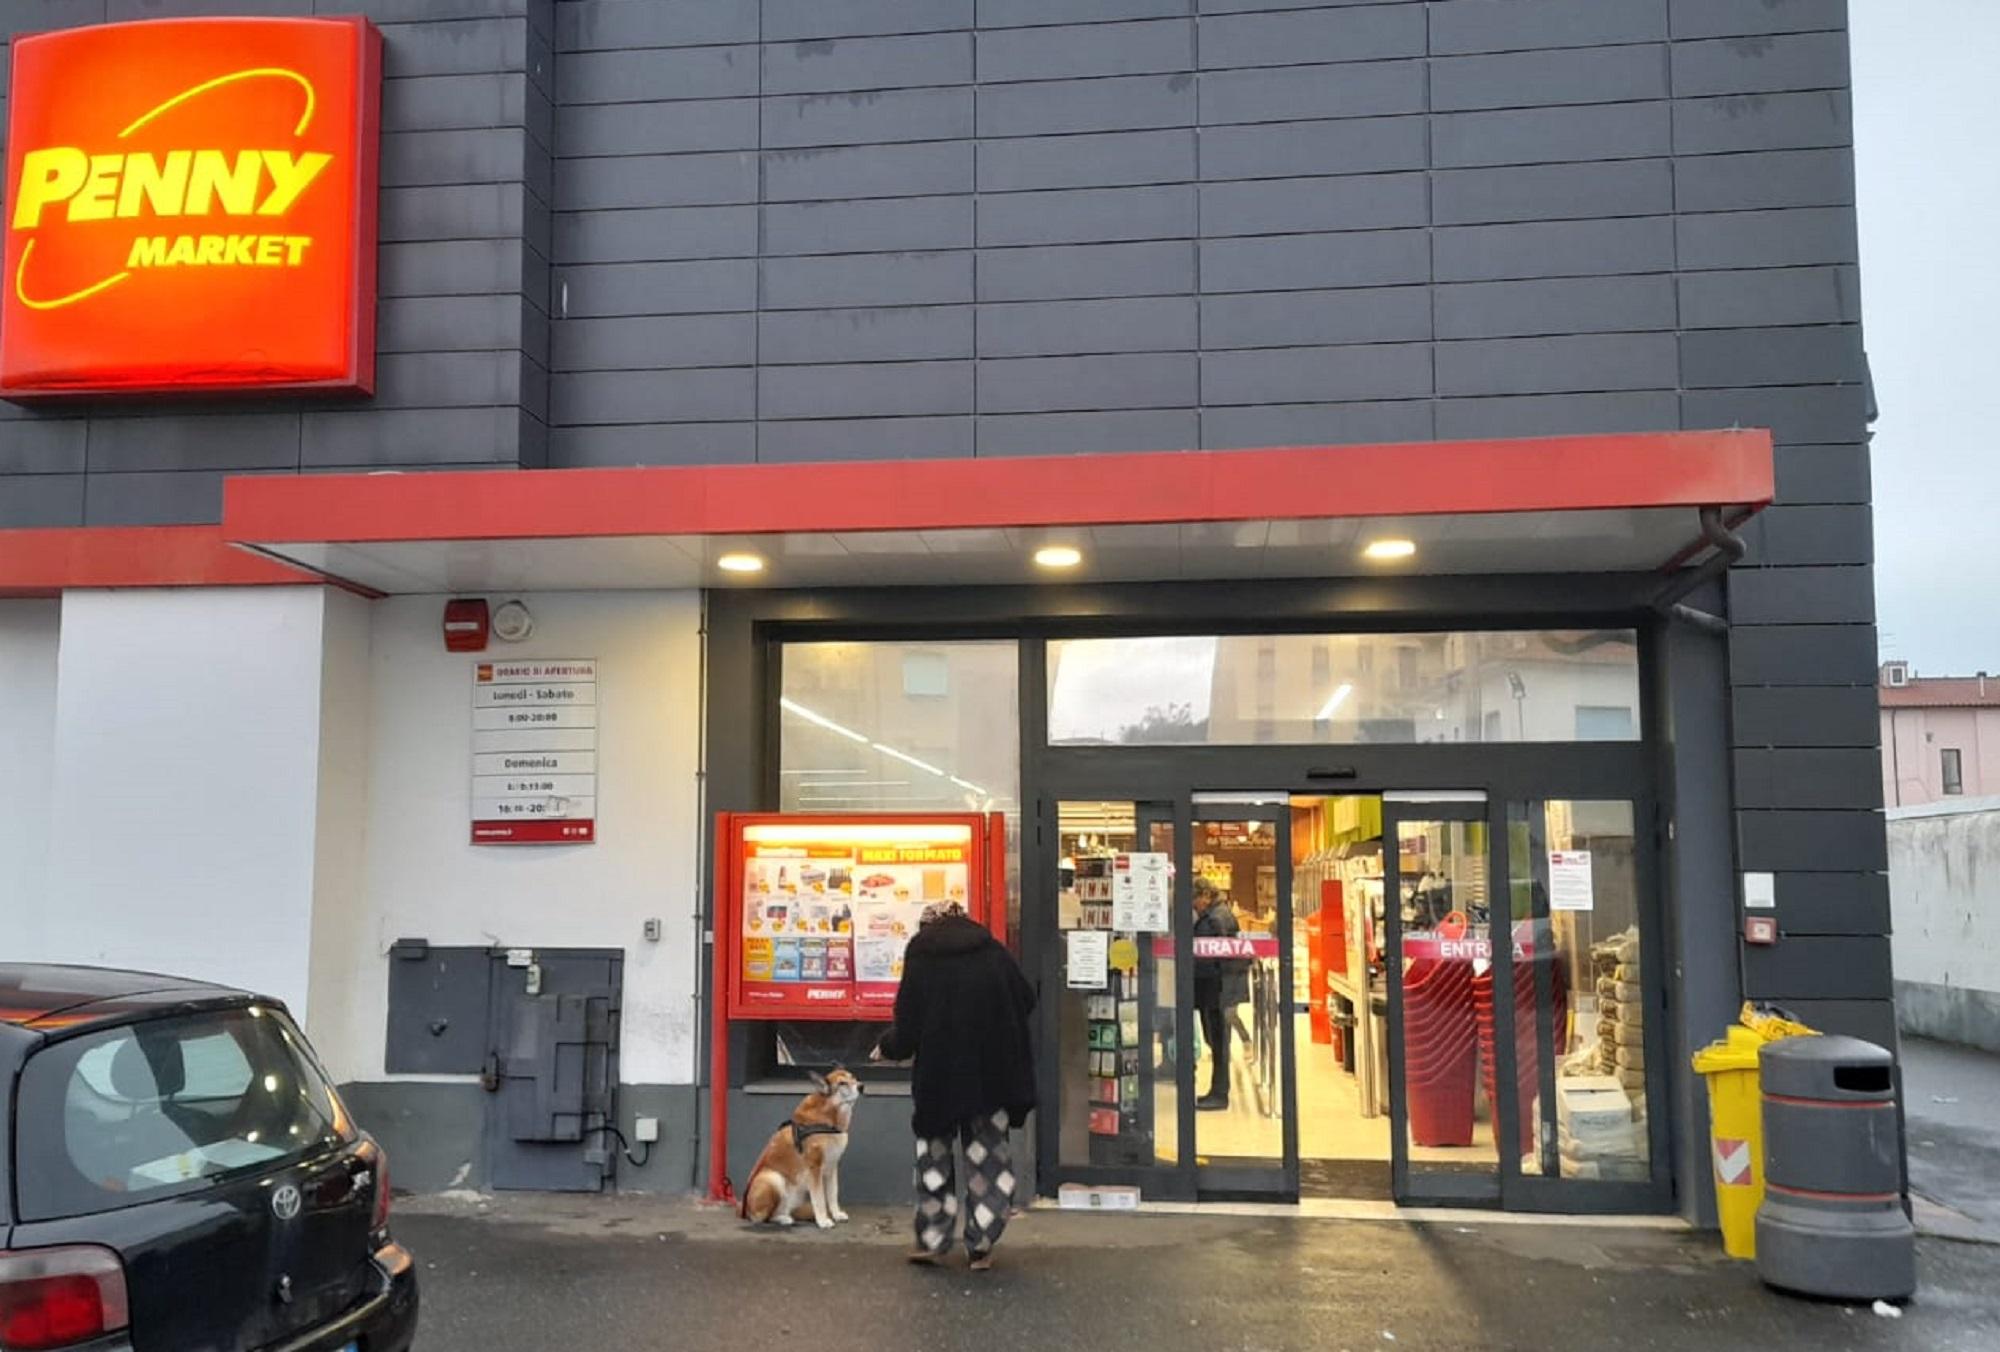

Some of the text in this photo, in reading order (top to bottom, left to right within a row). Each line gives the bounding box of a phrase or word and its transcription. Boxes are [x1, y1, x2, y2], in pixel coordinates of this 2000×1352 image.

[12, 146, 333, 230] PENNY
[126, 235, 312, 268] MARKET
[536, 688, 575, 700] Sabato
[504, 756, 558, 769] Domenica
[899, 847, 962, 862] FORMATO
